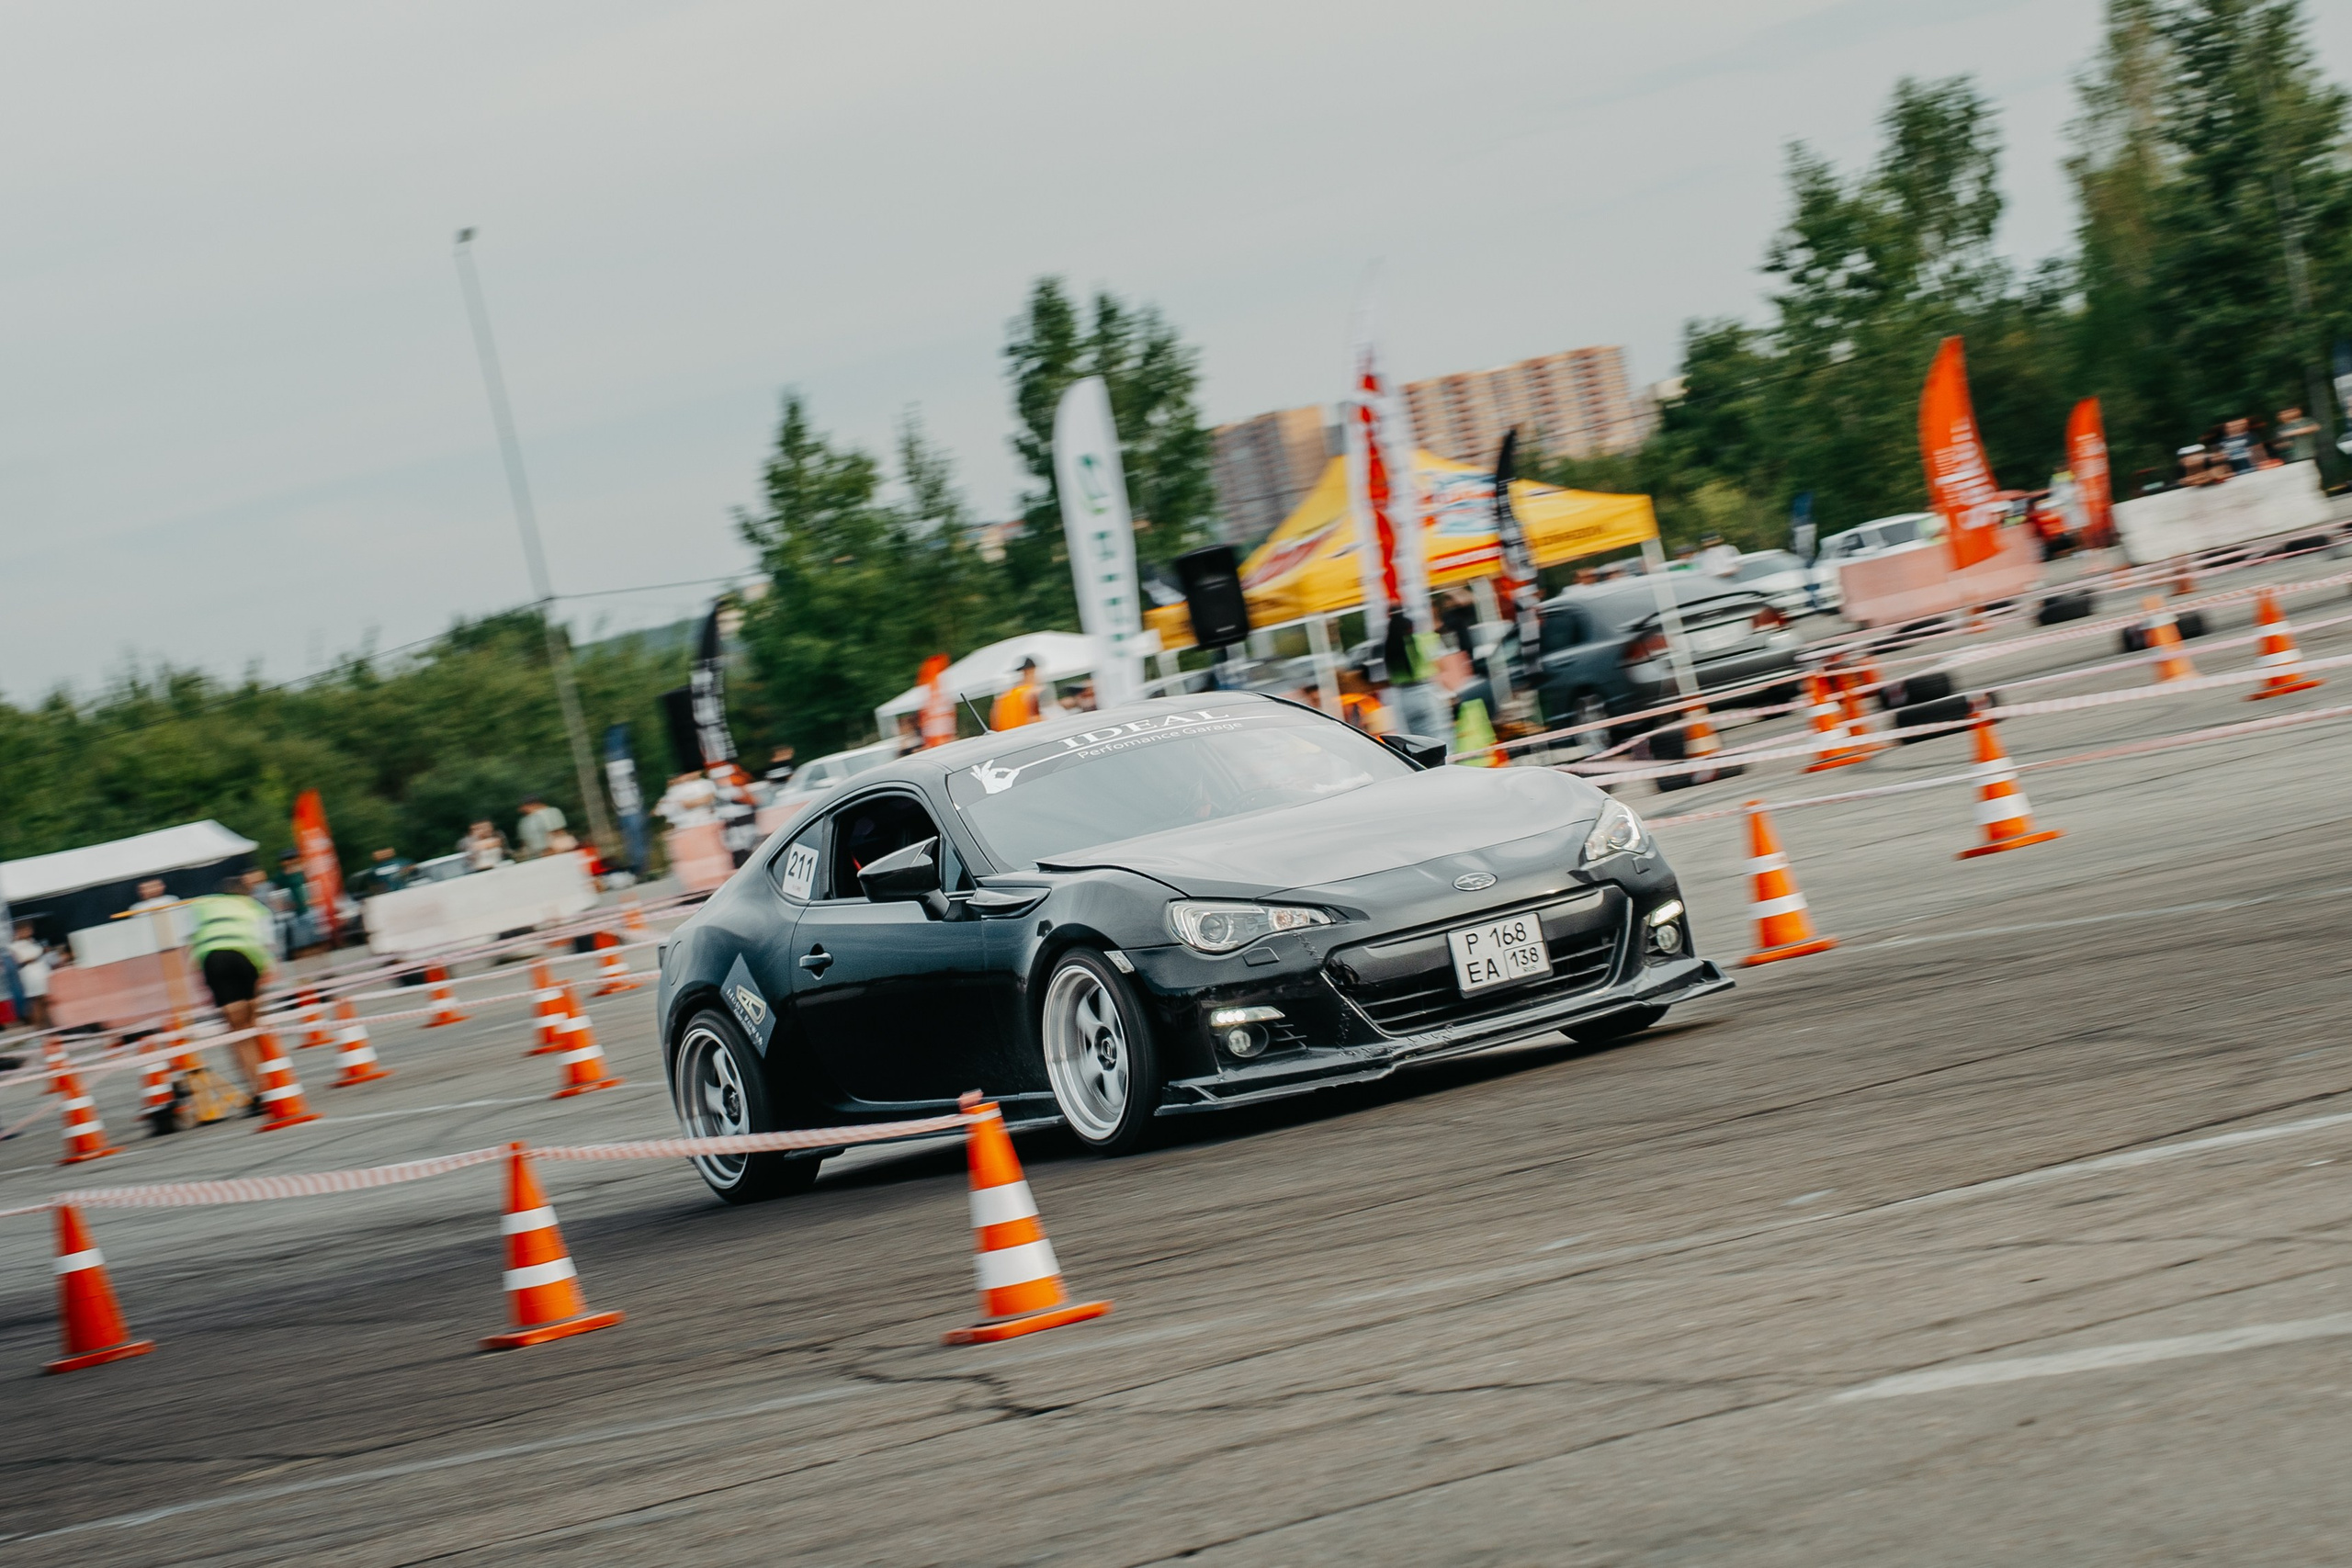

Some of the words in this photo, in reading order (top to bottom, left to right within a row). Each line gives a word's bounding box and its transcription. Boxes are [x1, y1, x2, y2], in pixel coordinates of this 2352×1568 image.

[1057, 711, 1229, 750] IDEAL
[1077, 730, 1181, 759] Perfomance
[1182, 720, 1243, 735] Garage
[788, 851, 813, 882] 211
[1489, 922, 1527, 948] 168
[1510, 947, 1539, 967] 138
